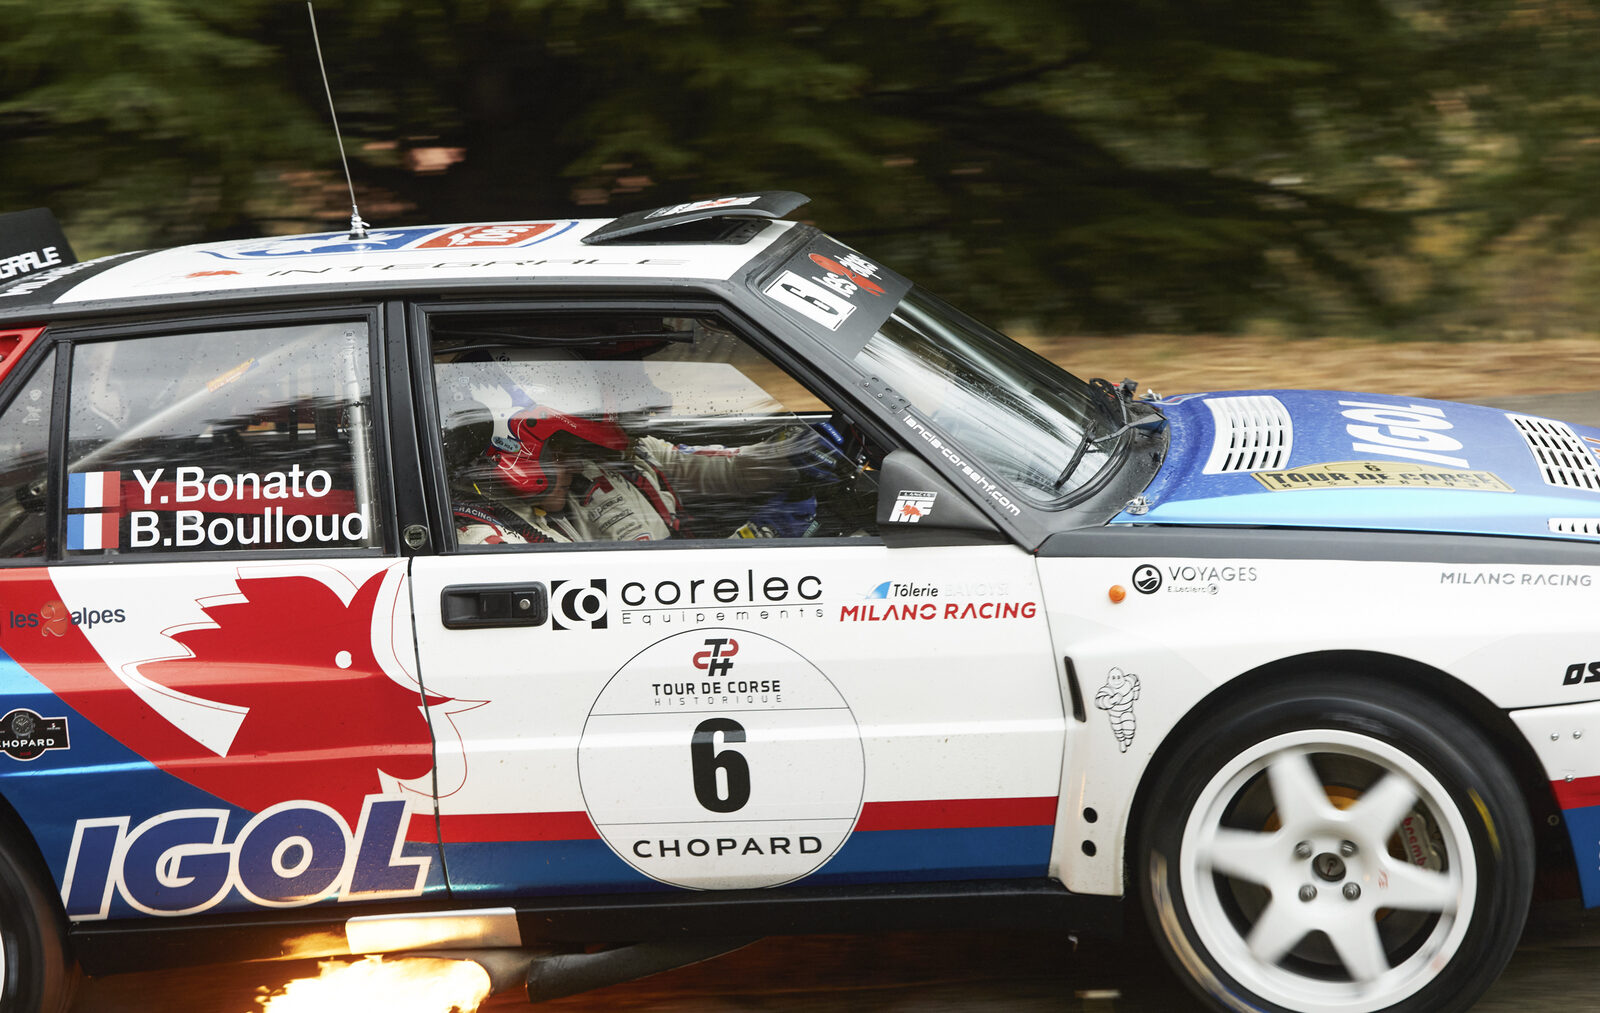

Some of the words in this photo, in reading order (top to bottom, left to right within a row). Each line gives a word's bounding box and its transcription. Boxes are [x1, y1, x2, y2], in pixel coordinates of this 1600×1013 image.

[1338, 400, 1470, 469] IGOL
[132, 463, 332, 505] Y.Bonato
[1266, 473, 1351, 485] TOUR
[1356, 472, 1395, 481] DE
[130, 503, 369, 548] B.Boulloud
[1168, 566, 1257, 581] VOYAGES
[1440, 572, 1515, 585] MILANO
[1521, 573, 1592, 587] RACING
[621, 569, 823, 607] corelec
[893, 582, 938, 597] Tôlerie
[10, 610, 39, 629] les
[70, 607, 126, 629] alpes
[622, 607, 824, 626] Equipements
[840, 603, 937, 622] MILANO
[944, 601, 1036, 619] RACING
[652, 682, 695, 696] TOUR
[701, 681, 721, 694] DE
[727, 680, 781, 694] CORSE
[654, 694, 783, 706] HISTORIQUE
[0, 738, 55, 748] HOPARD
[690, 717, 752, 813] 6
[61, 793, 432, 922] IGOL
[633, 836, 823, 859] CHOPARD
